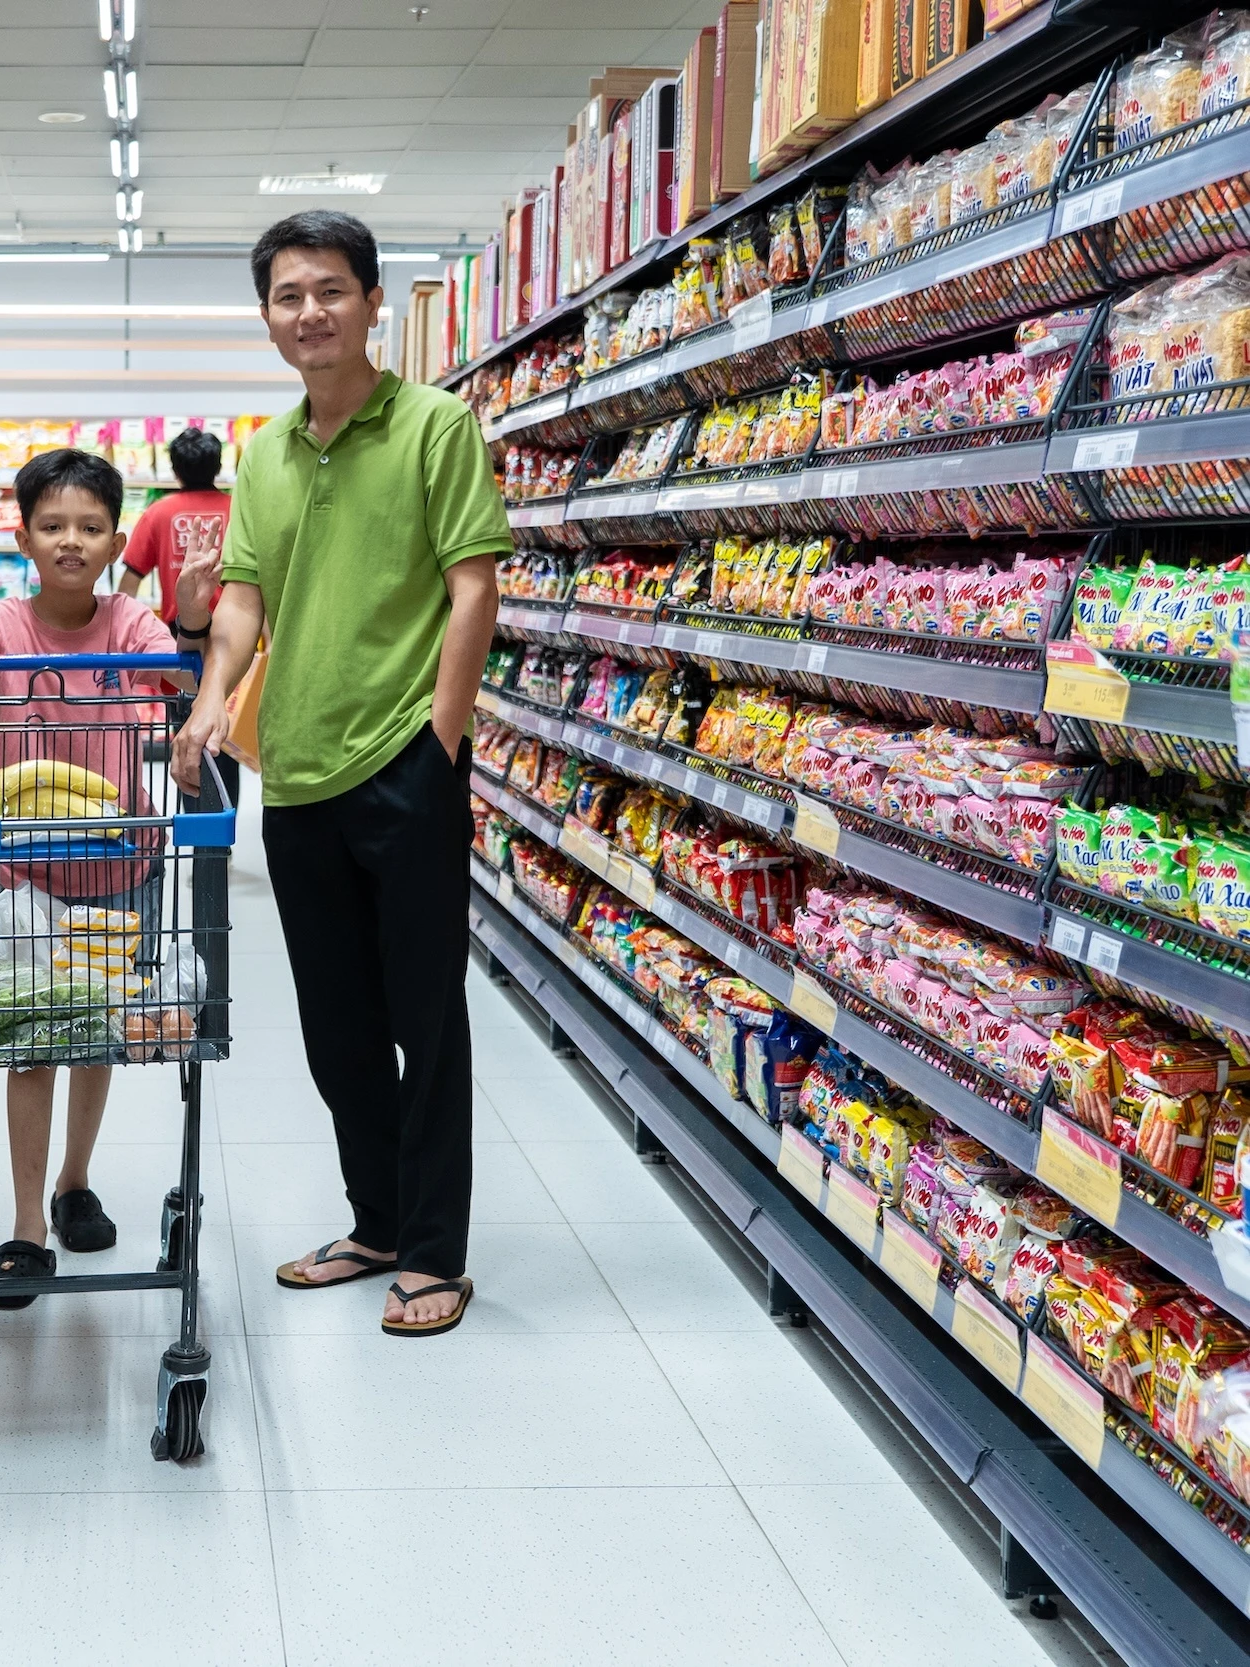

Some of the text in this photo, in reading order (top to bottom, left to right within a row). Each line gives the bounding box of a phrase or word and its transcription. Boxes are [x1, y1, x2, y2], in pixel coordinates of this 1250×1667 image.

[1125, 353, 1155, 392] VẮT
[1137, 572, 1154, 588] Hảo
[1218, 860, 1237, 880] Hảo
